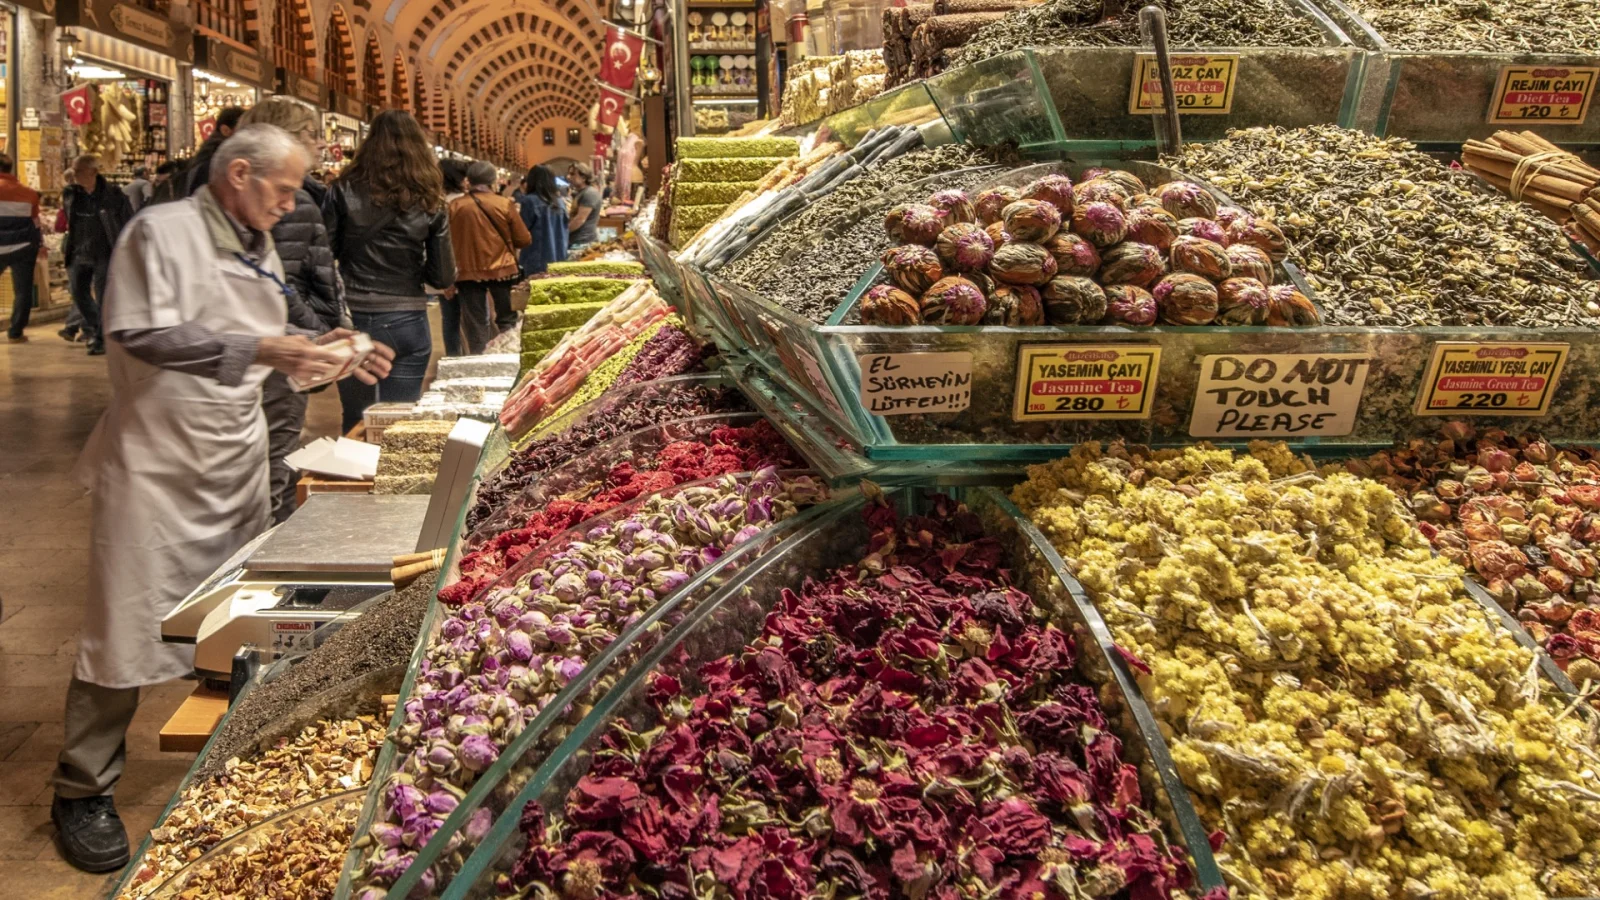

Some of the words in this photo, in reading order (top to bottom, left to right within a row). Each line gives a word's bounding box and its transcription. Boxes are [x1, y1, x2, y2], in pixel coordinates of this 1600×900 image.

[1196, 68, 1224, 81] ÇAY
[1197, 82, 1217, 92] Tea
[1553, 81, 1585, 93] ÇAYI
[1516, 93, 1544, 103] Diet
[1548, 93, 1570, 103] Tea
[1520, 105, 1551, 117] 120
[870, 356, 900, 374] EL
[1107, 363, 1142, 380] ÇAYI
[1211, 357, 1278, 383] DO
[1281, 357, 1370, 385] NOT
[1038, 382, 1103, 394] Jasmine
[1107, 381, 1135, 393] Tea
[1443, 378, 1485, 389] Jasmine
[1487, 378, 1518, 389] Green
[1520, 378, 1539, 390] Tea
[1206, 387, 1330, 407] TOUCH
[1457, 393, 1508, 407] 220
[1029, 403, 1046, 411] 1KG
[1055, 397, 1105, 411] 280
[1215, 409, 1337, 433] PLEASE
